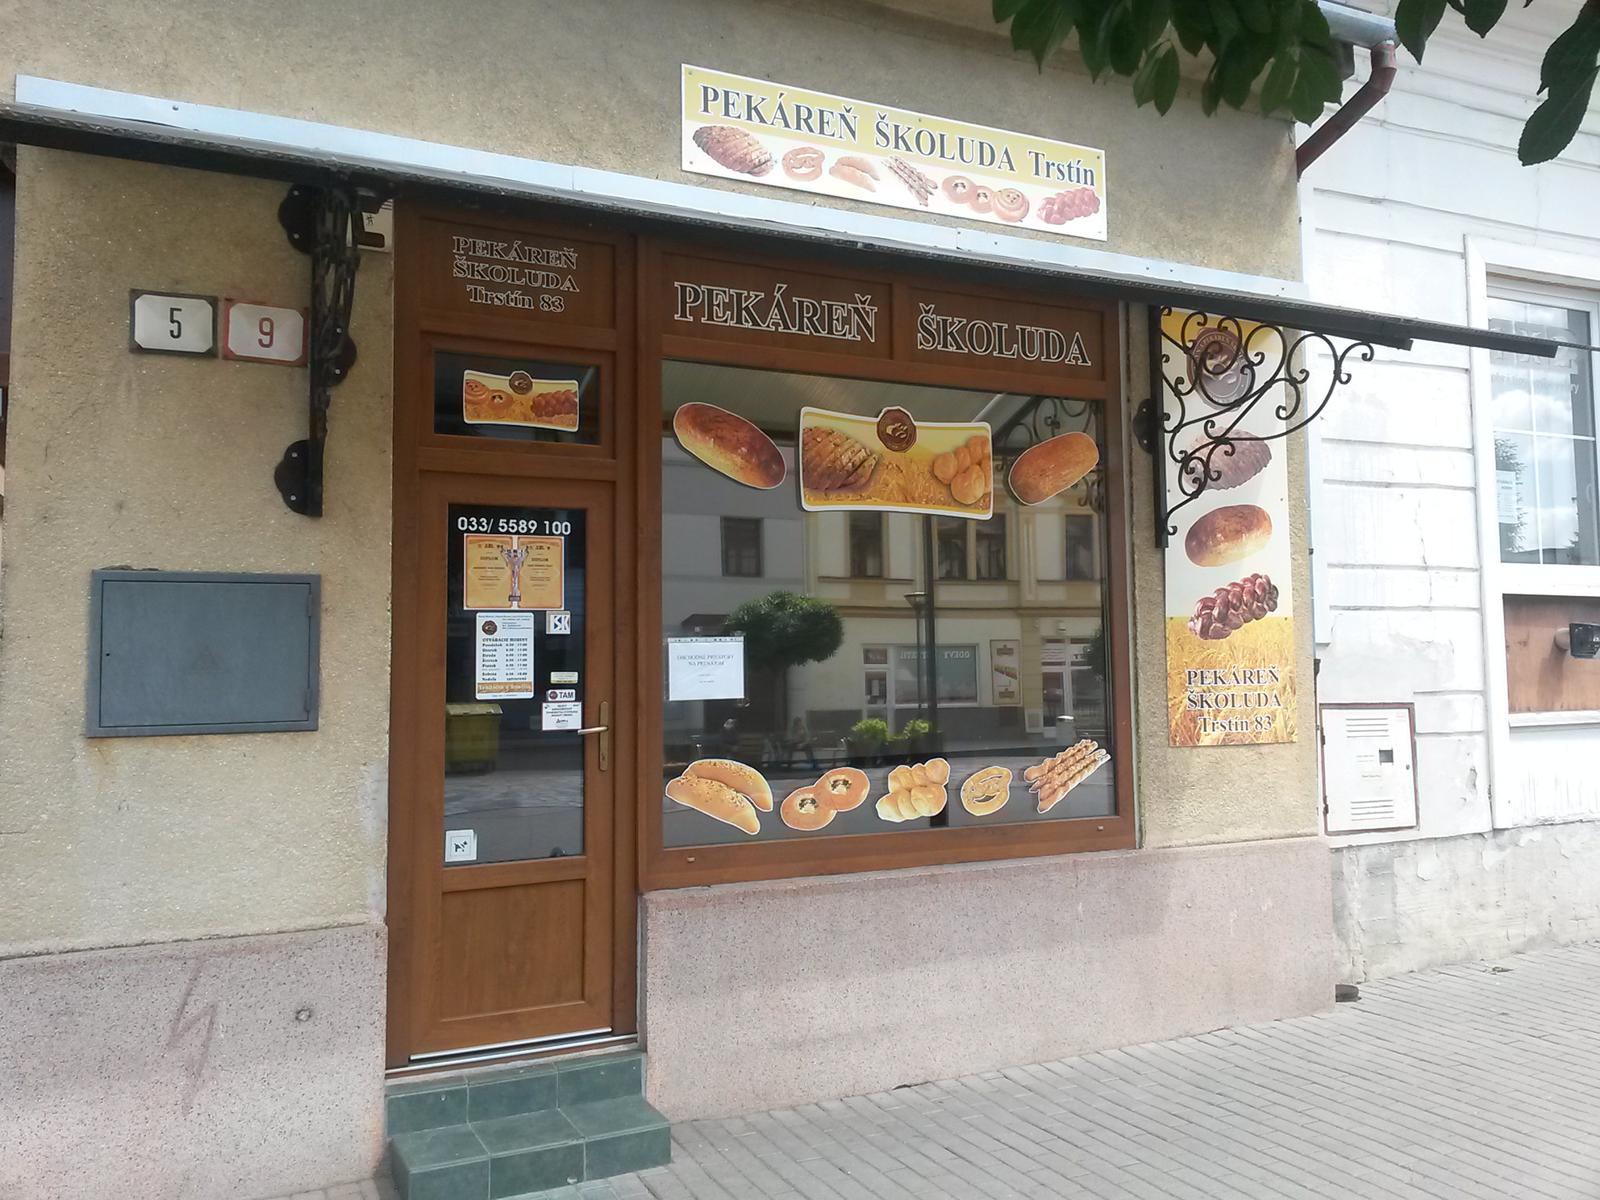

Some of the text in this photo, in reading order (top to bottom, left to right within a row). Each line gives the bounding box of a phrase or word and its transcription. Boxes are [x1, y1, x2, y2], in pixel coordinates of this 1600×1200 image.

[700, 84, 1097, 187] PEKÁREŇ ŠKOLUDA Trstín
[453, 236, 578, 270] PEKÁREŇ
[453, 255, 580, 293] ŠKOLUDA
[466, 284, 565, 313] Trstín 83
[169, 307, 182, 339] 5
[258, 317, 274, 348] 9
[674, 281, 1091, 367] PEKÁREŇ ŠKOLUDA
[457, 516, 571, 535] 033/ 5589 100
[1186, 665, 1281, 686] PEKÁREŇ
[1186, 689, 1282, 709] ŠKOLUDA
[1198, 715, 1272, 733] Trstín 83
